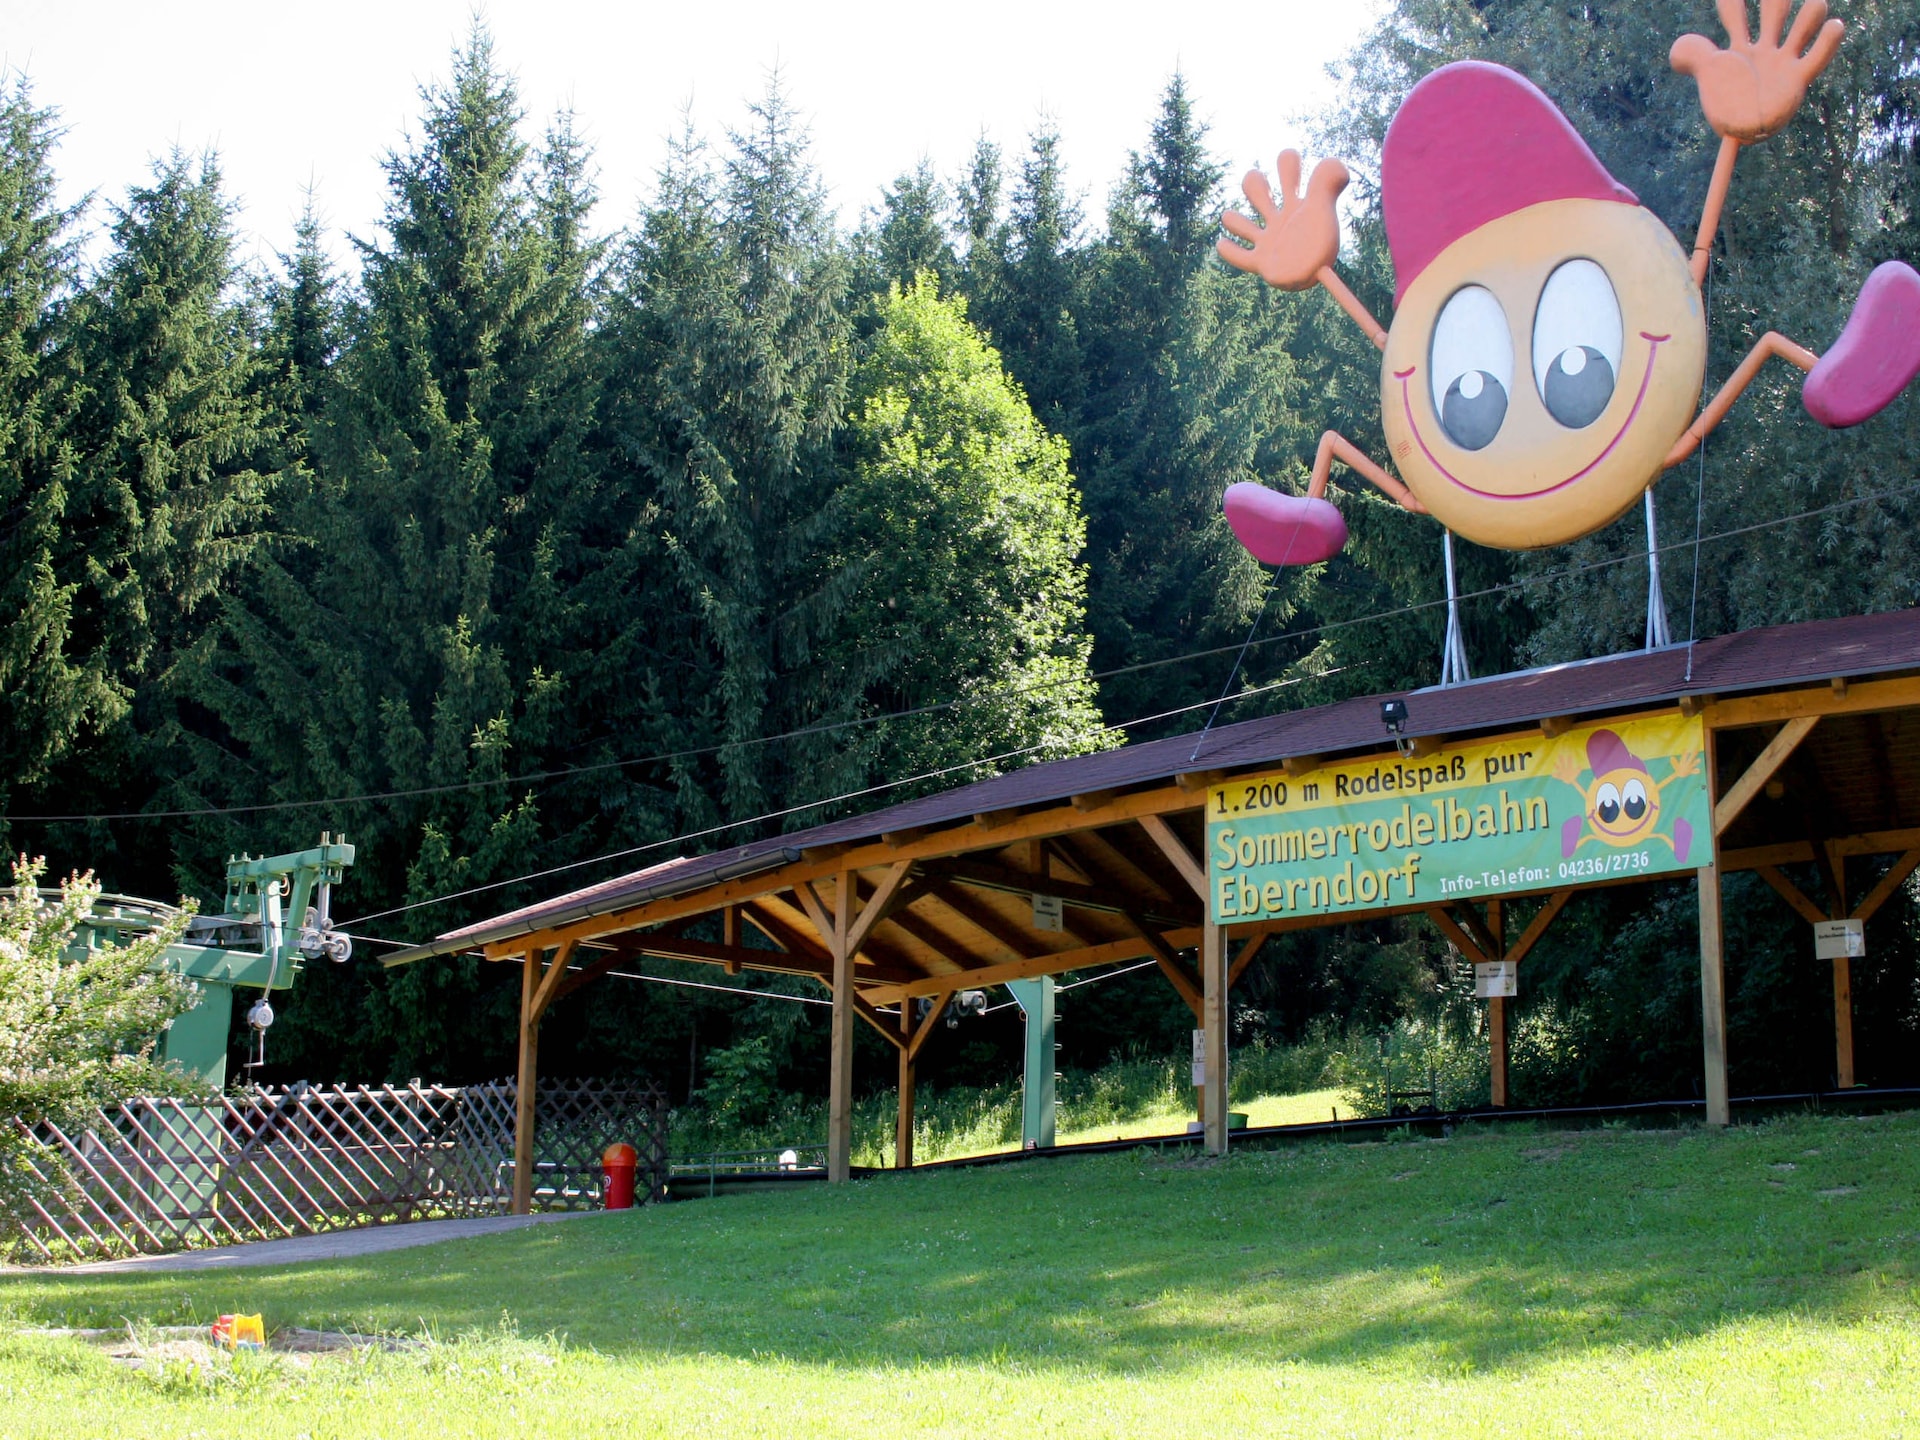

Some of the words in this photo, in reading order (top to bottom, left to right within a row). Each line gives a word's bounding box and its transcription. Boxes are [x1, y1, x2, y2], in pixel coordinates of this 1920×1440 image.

[1216, 782, 1288, 814] 1.200
[1303, 783, 1319, 802] m
[1335, 755, 1466, 798] Rodelspaß
[1484, 751, 1533, 783] pur
[1216, 789, 1550, 870] Sommerrodelbahn
[1217, 852, 1422, 918] Eberndorf
[1440, 866, 1551, 893] Info-Telefon:
[1558, 851, 1650, 879] 04236/2736
